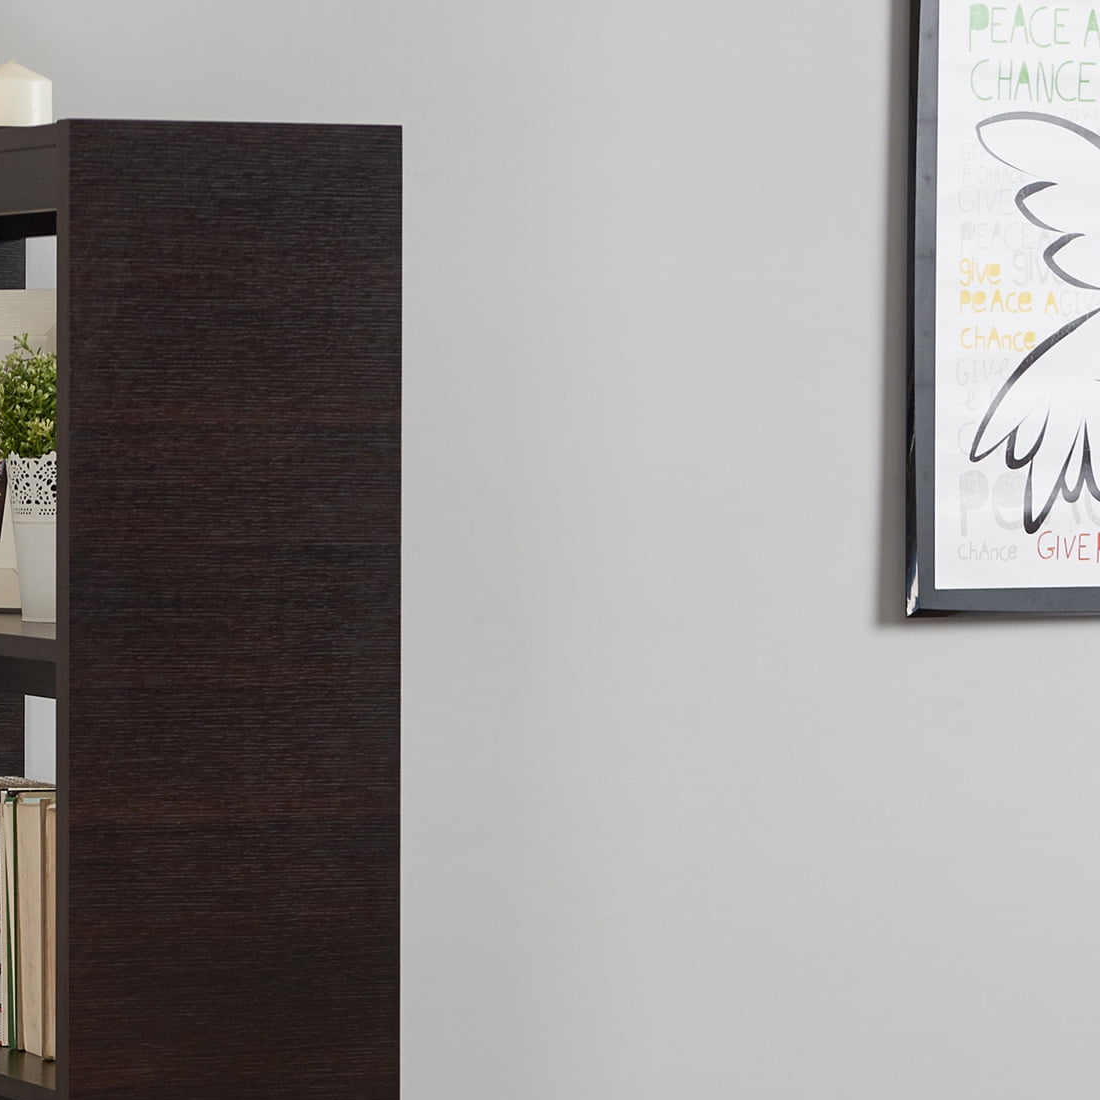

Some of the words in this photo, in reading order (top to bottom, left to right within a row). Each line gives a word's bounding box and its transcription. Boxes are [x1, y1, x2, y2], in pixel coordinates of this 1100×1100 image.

[969, 3, 1071, 51] PEACE
[970, 58, 1097, 103] CHANCE
[958, 257, 1003, 286] give
[1036, 530, 1093, 561] GIVE
